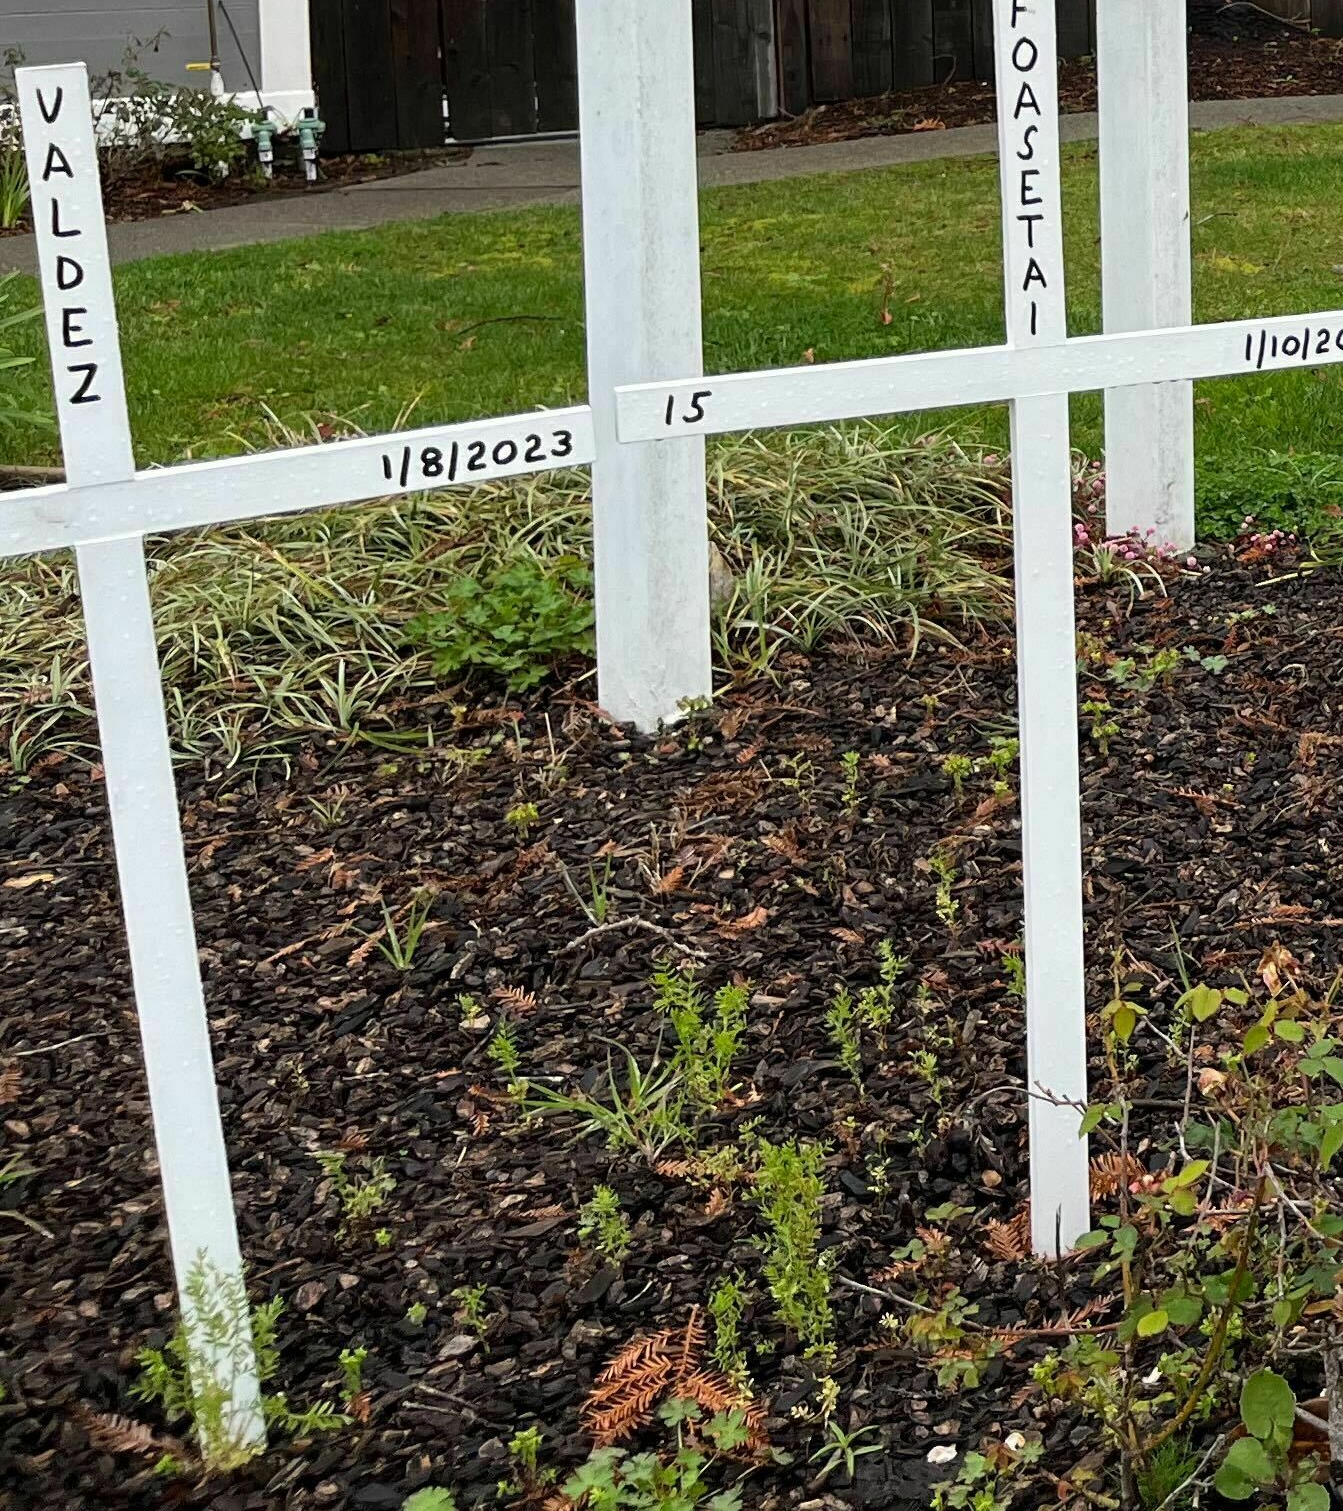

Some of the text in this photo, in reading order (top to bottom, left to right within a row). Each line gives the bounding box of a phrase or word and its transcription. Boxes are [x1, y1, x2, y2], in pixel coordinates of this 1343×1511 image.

[36, 86, 101, 404] VALDEZ
[665, 390, 712, 425] 15
[381, 429, 573, 486] 1/8/2023
